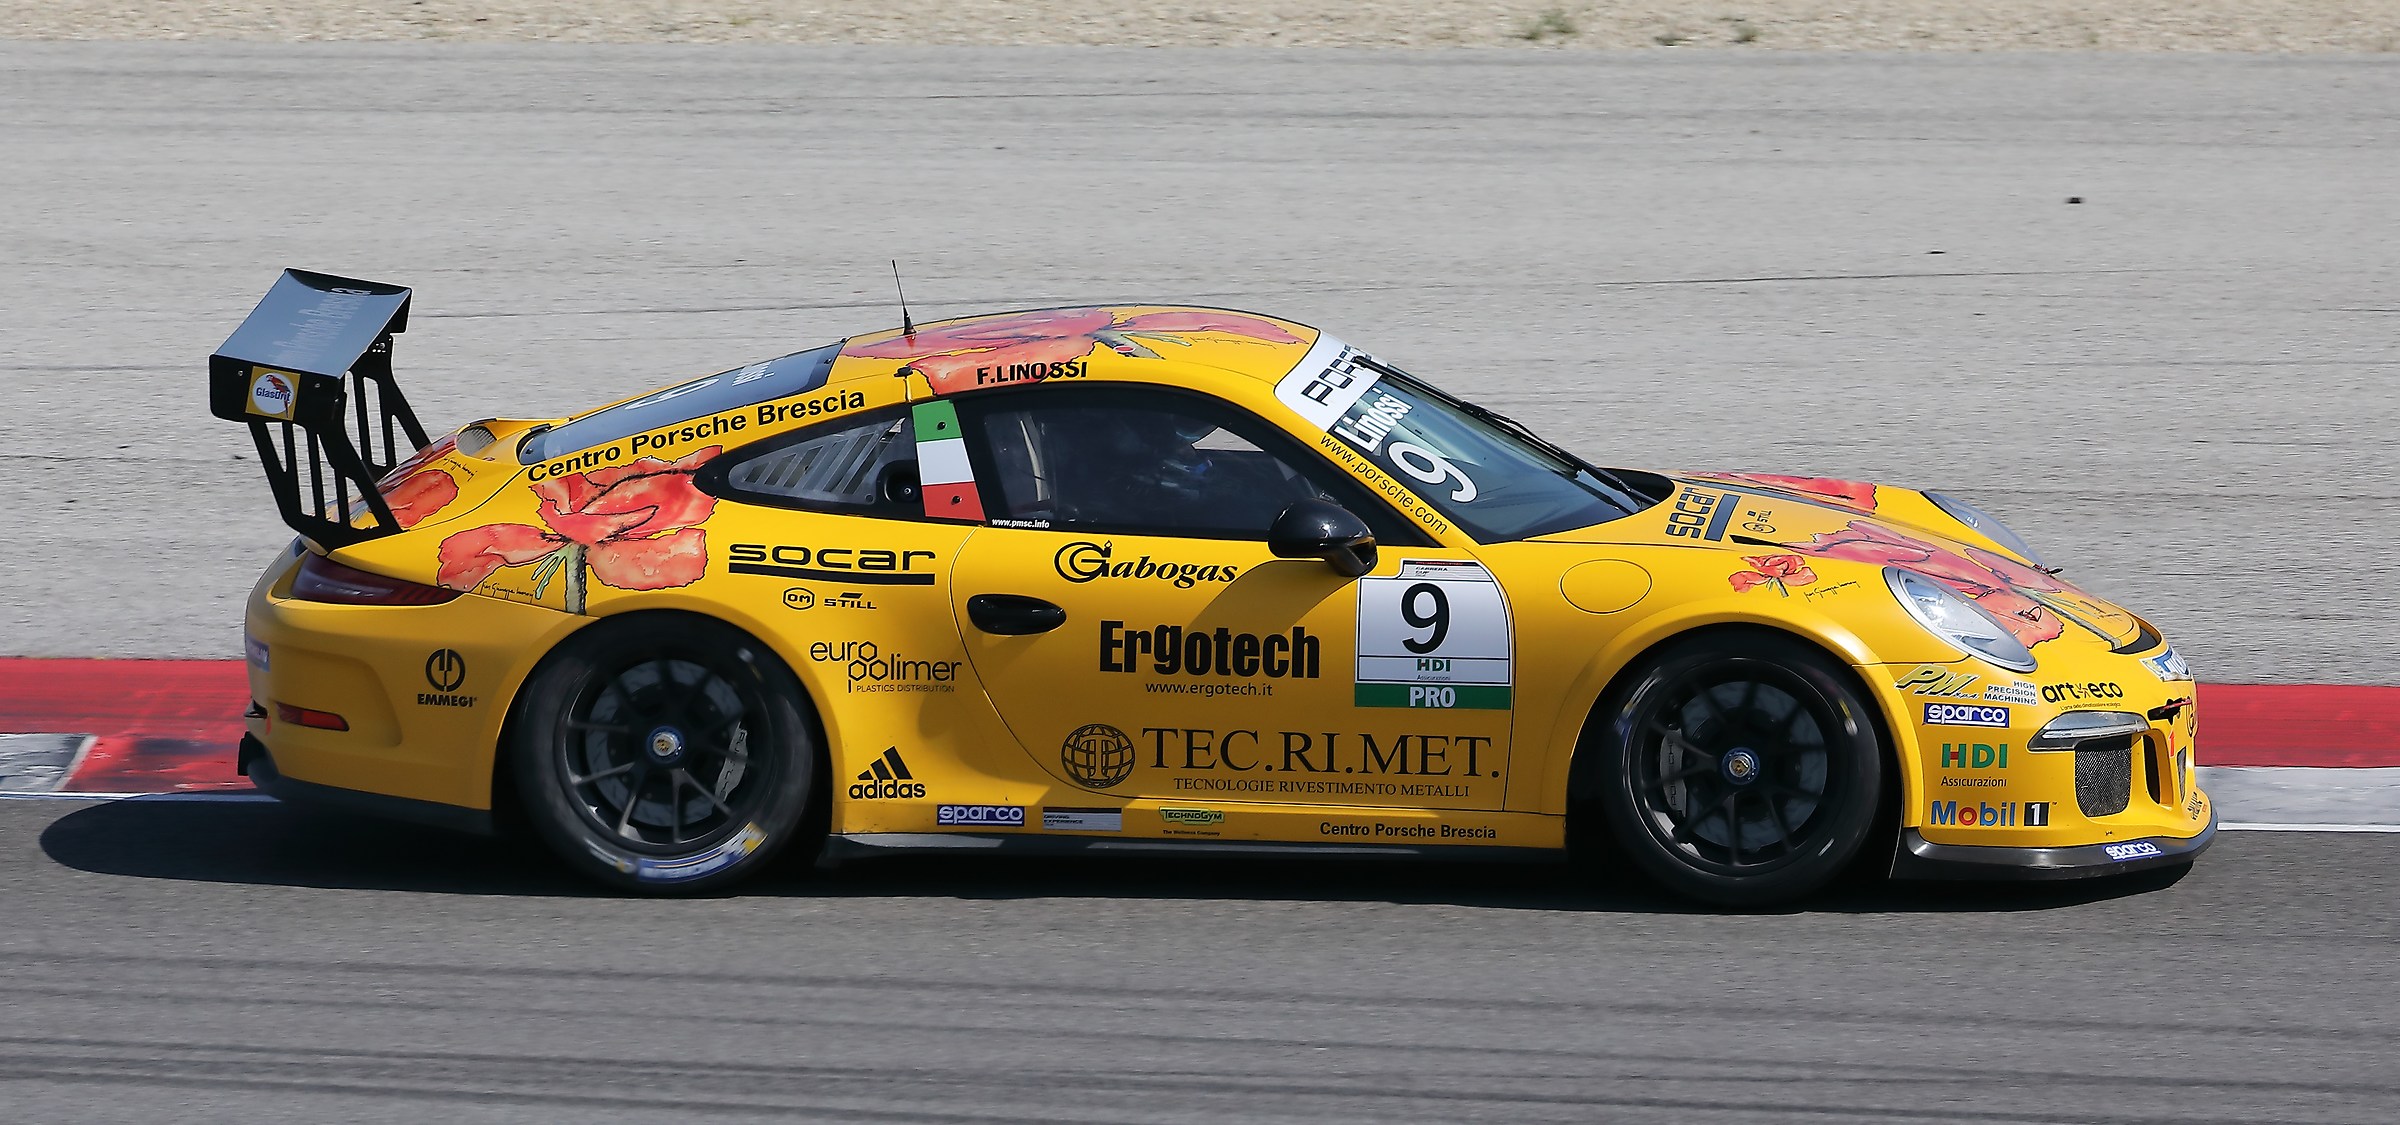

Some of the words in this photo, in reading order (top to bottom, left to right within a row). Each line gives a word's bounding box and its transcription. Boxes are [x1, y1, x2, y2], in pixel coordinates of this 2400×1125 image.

[976, 361, 1088, 385] F.LINOSSI
[1334, 387, 1413, 453] Linossi
[528, 446, 621, 482] Centro
[631, 414, 747, 455] Porsche
[757, 389, 866, 426] Brescia
[1388, 440, 1479, 504] 9
[1320, 435, 1449, 536] www.porsche.com
[992, 518, 1050, 529] www.pmsc.info
[729, 543, 937, 571] socar
[1054, 540, 1238, 589] Gabogas
[787, 592, 811, 604] OM
[824, 598, 877, 610] STILL
[1401, 582, 1450, 655] 9
[810, 640, 878, 663] euro
[1100, 620, 1320, 679] Ergotech
[1416, 658, 1451, 672] HDI
[856, 684, 895, 693] PLASTICS
[897, 684, 955, 693] DISTRIBUTION
[1146, 682, 1273, 698] www.ergotech.it
[1987, 685, 2037, 698] PRECISION
[2013, 680, 2036, 690] HIGH
[417, 694, 473, 708] EMMEGI
[1409, 686, 1456, 708] PRO
[1983, 693, 2038, 705] MACHINING
[1928, 705, 2006, 725] sparco
[1141, 727, 1500, 779] TEC.RI.MET.
[1941, 743, 2008, 769] HDI
[848, 778, 927, 800] adidas
[1174, 778, 1274, 792] TECNOLOGIE
[1279, 780, 1396, 795] RIVESTIMENTO
[1400, 784, 1469, 797] METALLI
[1940, 775, 2007, 788] Assicurazioni
[938, 804, 1023, 824] sparco
[1931, 800, 2016, 827] Mobil
[1320, 821, 1370, 836] Centro
[1375, 823, 1436, 838] Porsche
[1440, 824, 1497, 839] Brescia
[2104, 841, 2158, 859] sparco
